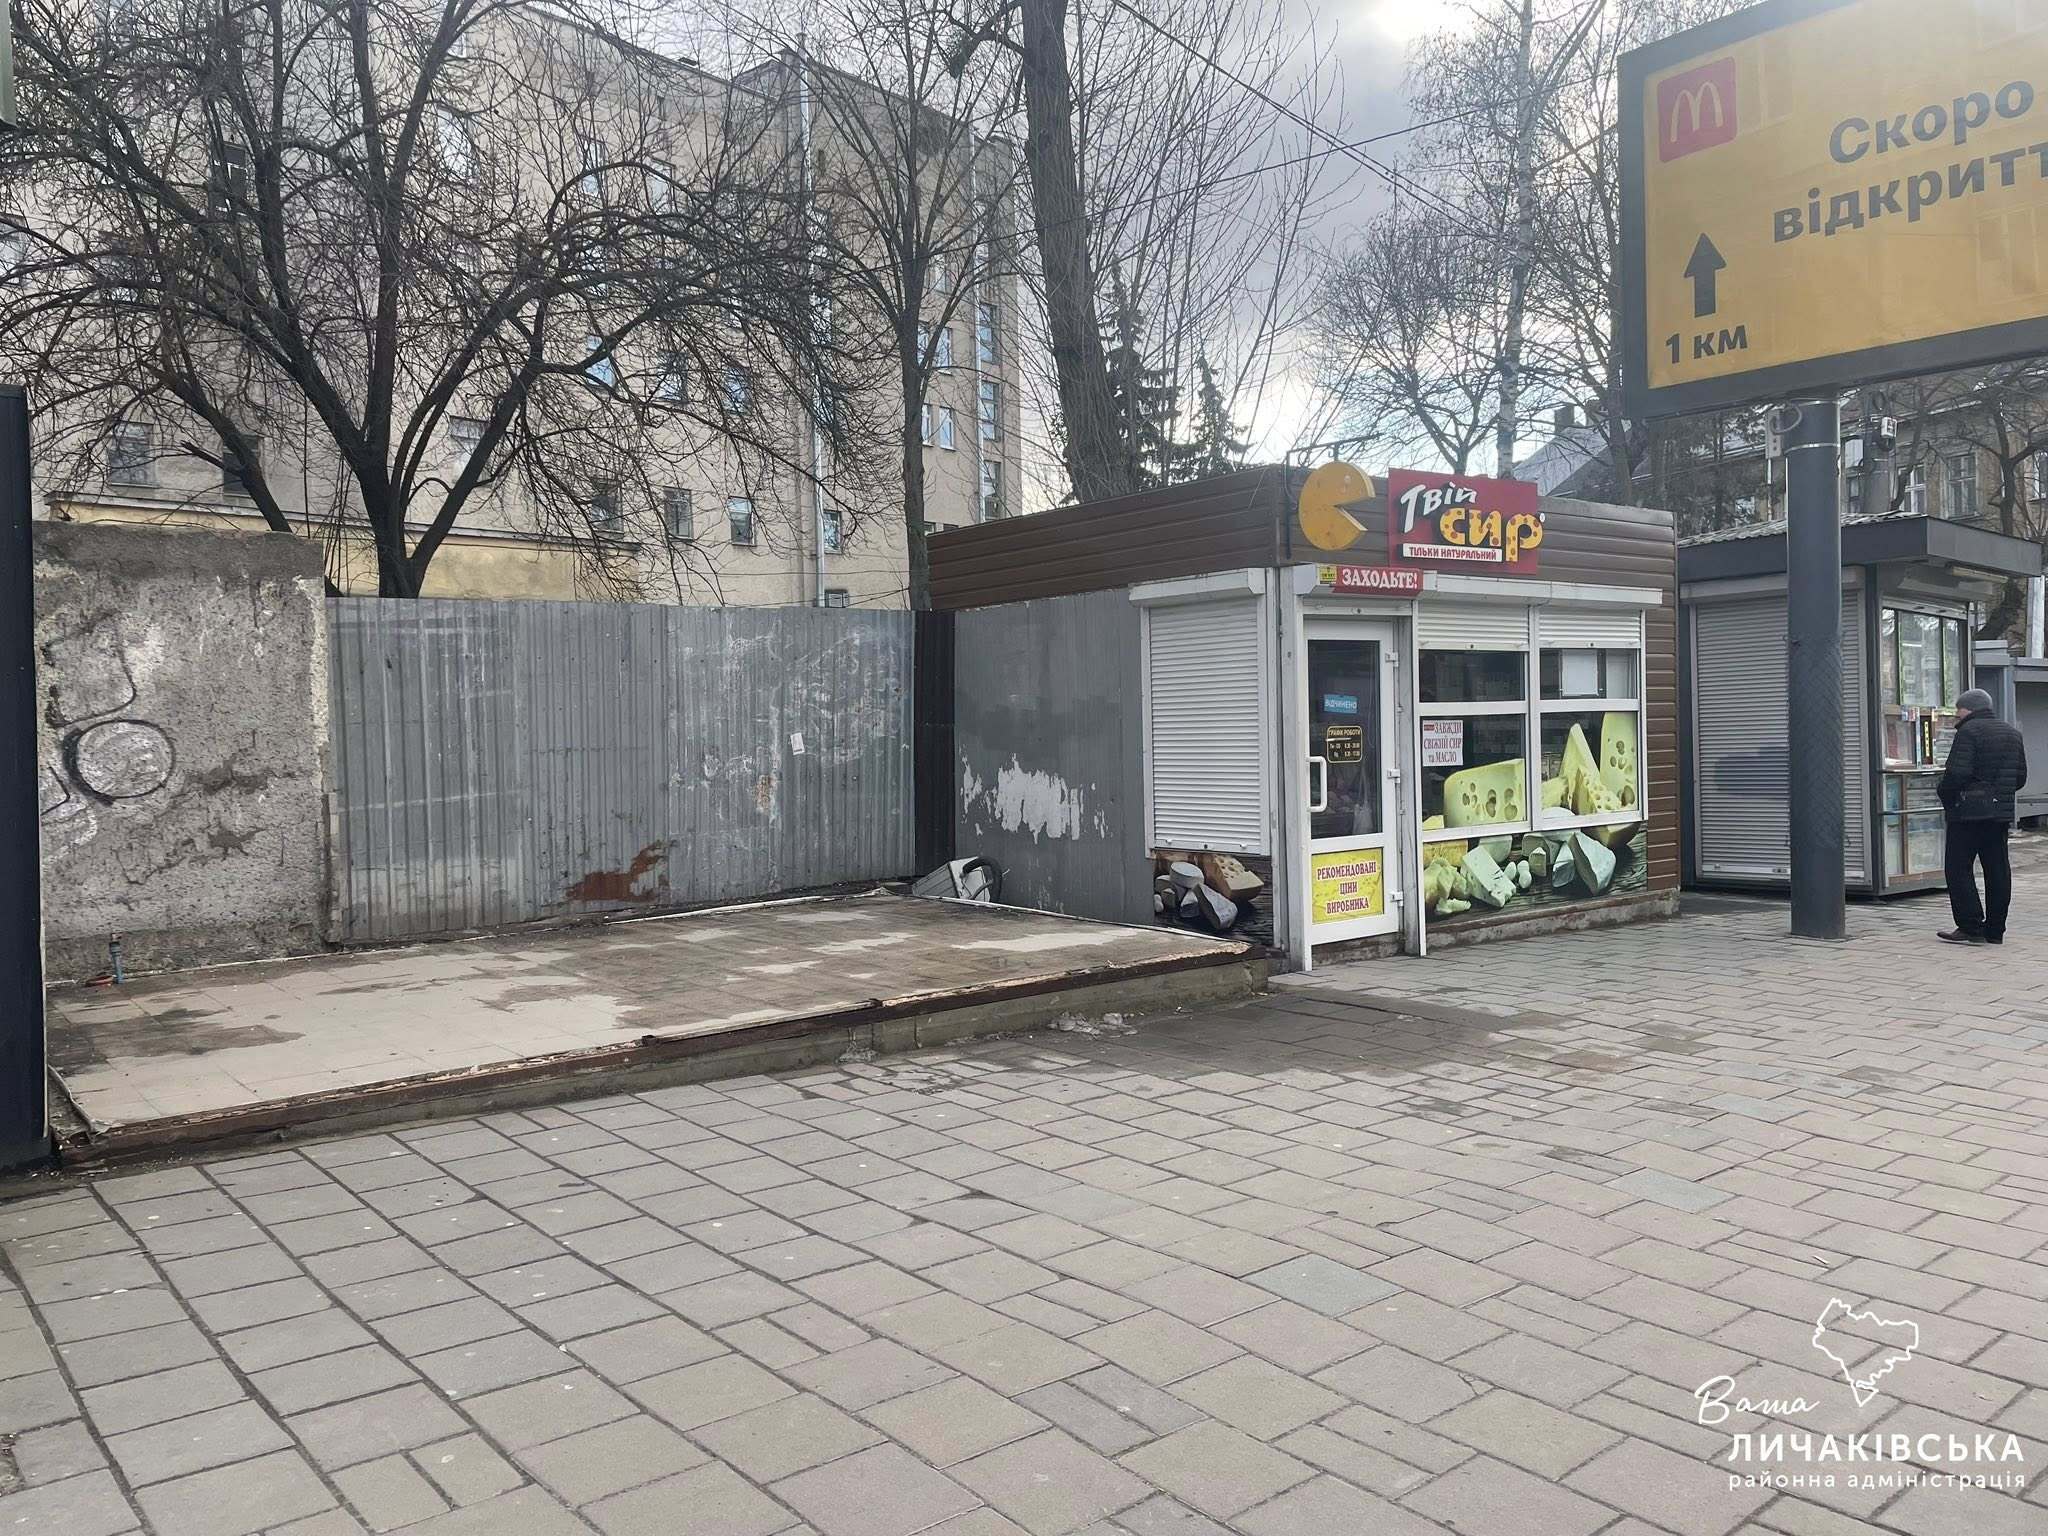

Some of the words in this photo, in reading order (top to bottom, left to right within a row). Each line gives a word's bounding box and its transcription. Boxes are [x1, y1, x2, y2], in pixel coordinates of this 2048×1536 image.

[1829, 80, 2034, 164] Скоро
[1666, 332, 1680, 364] 1
[1694, 325, 1748, 360] км
[1401, 481, 1477, 533] Твій
[1409, 546, 1439, 557] ТІЛЬКИ
[1441, 549, 1497, 560] НАТУРАЛЬНИЙ
[1342, 568, 1418, 589] ЗАХОДЬТЕ!
[1435, 722, 1462, 734] ЗАВЖДИ
[1424, 736, 1448, 749] СВІЖИЙ
[1449, 738, 1461, 749] СИР
[1435, 752, 1457, 763] МАСЛО
[1317, 861, 1377, 880] РЕКОМЕНДОВАНІ
[1339, 881, 1357, 895] ЦІНИ
[1326, 898, 1369, 914] ВИРОБНИКА
